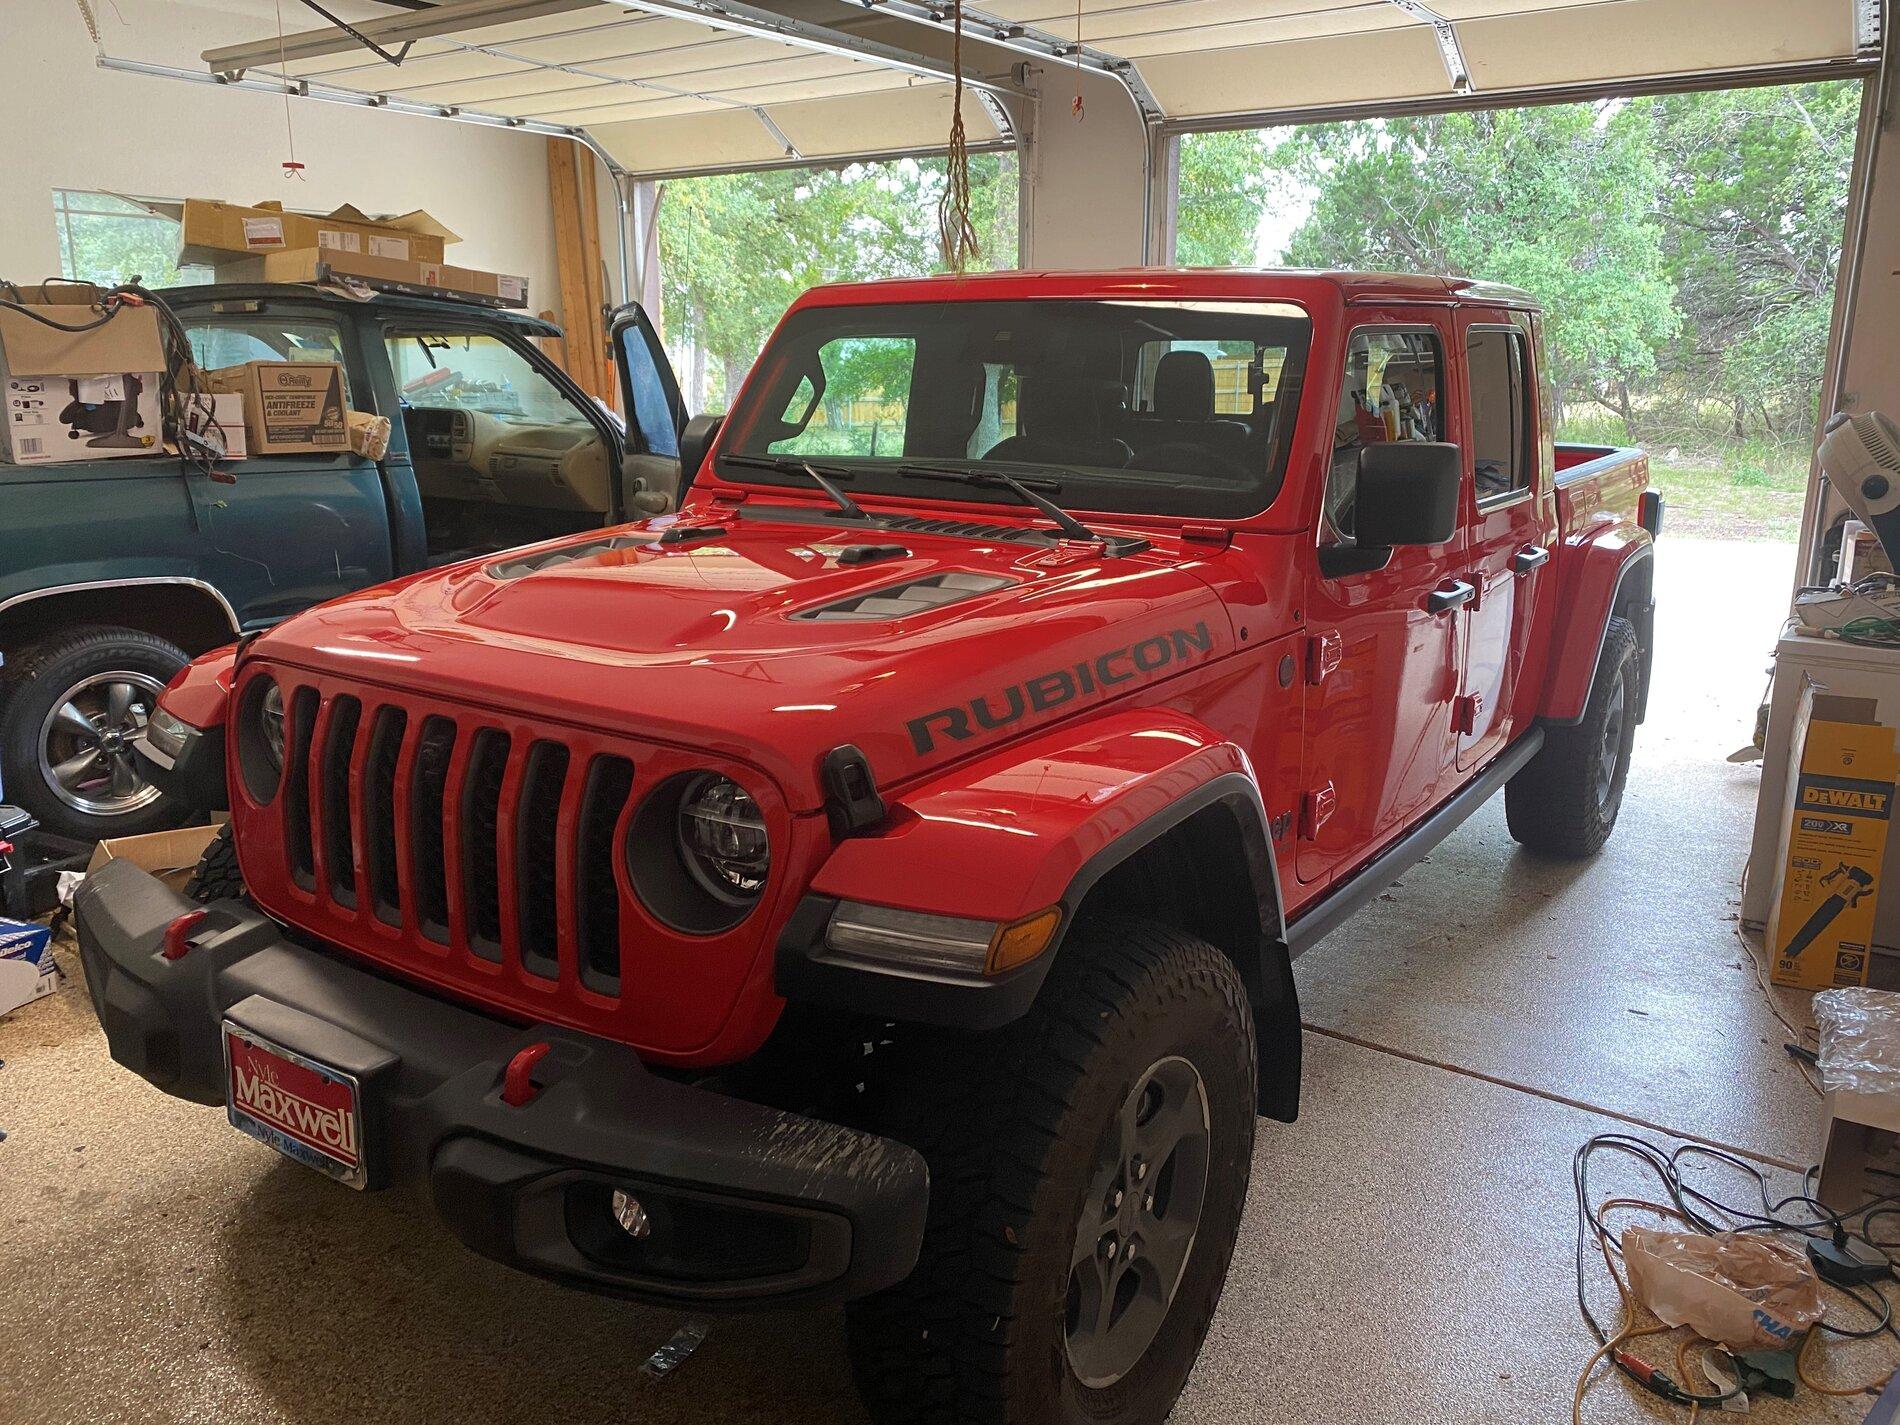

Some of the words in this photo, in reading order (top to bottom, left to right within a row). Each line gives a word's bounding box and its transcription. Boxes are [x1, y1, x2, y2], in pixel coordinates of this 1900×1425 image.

[266, 401, 316, 410] ANTIFREEZE
[905, 621, 1213, 756] RUBICON
[1832, 822, 1848, 832] XR
[1779, 959, 1793, 970] 90
[247, 1055, 279, 1087] Nyle
[235, 1066, 356, 1156] Maxwell
